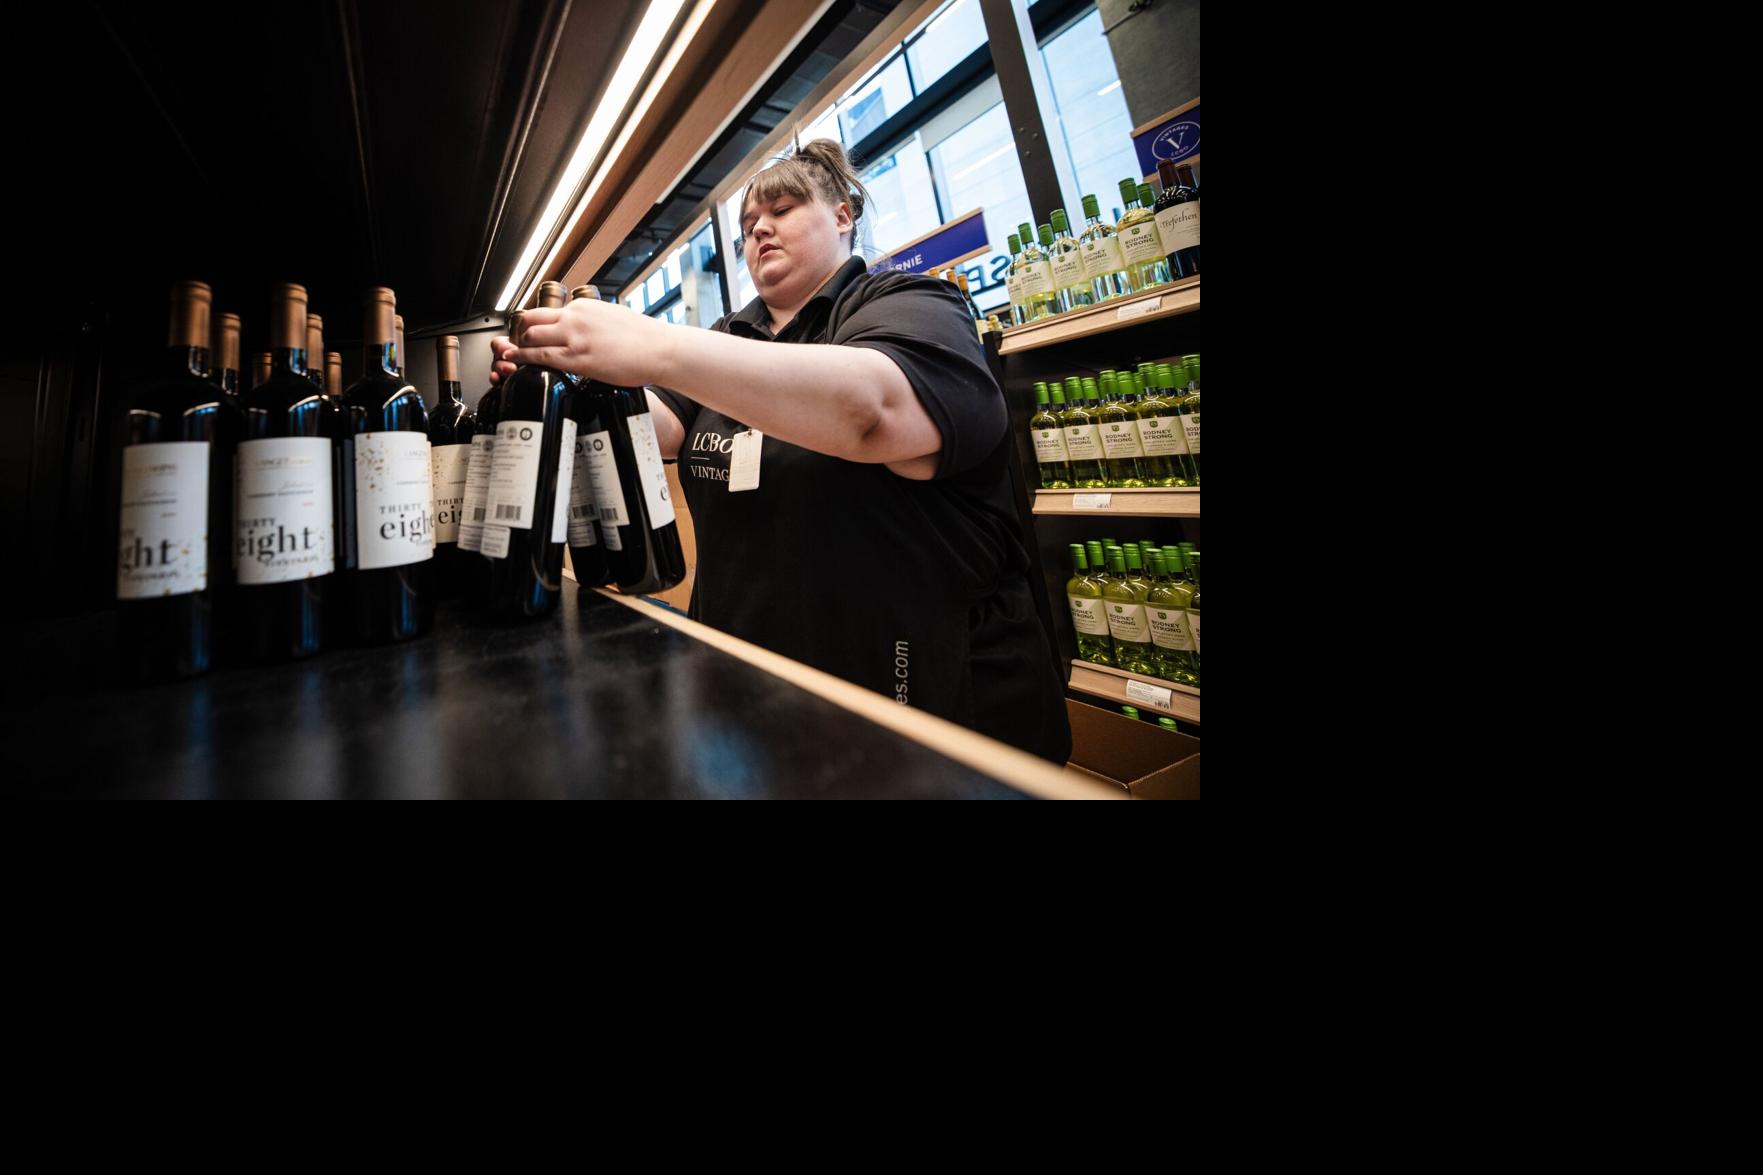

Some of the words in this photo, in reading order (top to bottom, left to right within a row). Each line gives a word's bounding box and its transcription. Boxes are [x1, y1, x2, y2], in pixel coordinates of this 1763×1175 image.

[1166, 131, 1186, 150] V
[1125, 233, 1153, 245] RODNEY
[1126, 237, 1154, 250] STRONG
[690, 465, 730, 482] VINTAG
[895, 640, 909, 705] es.com
